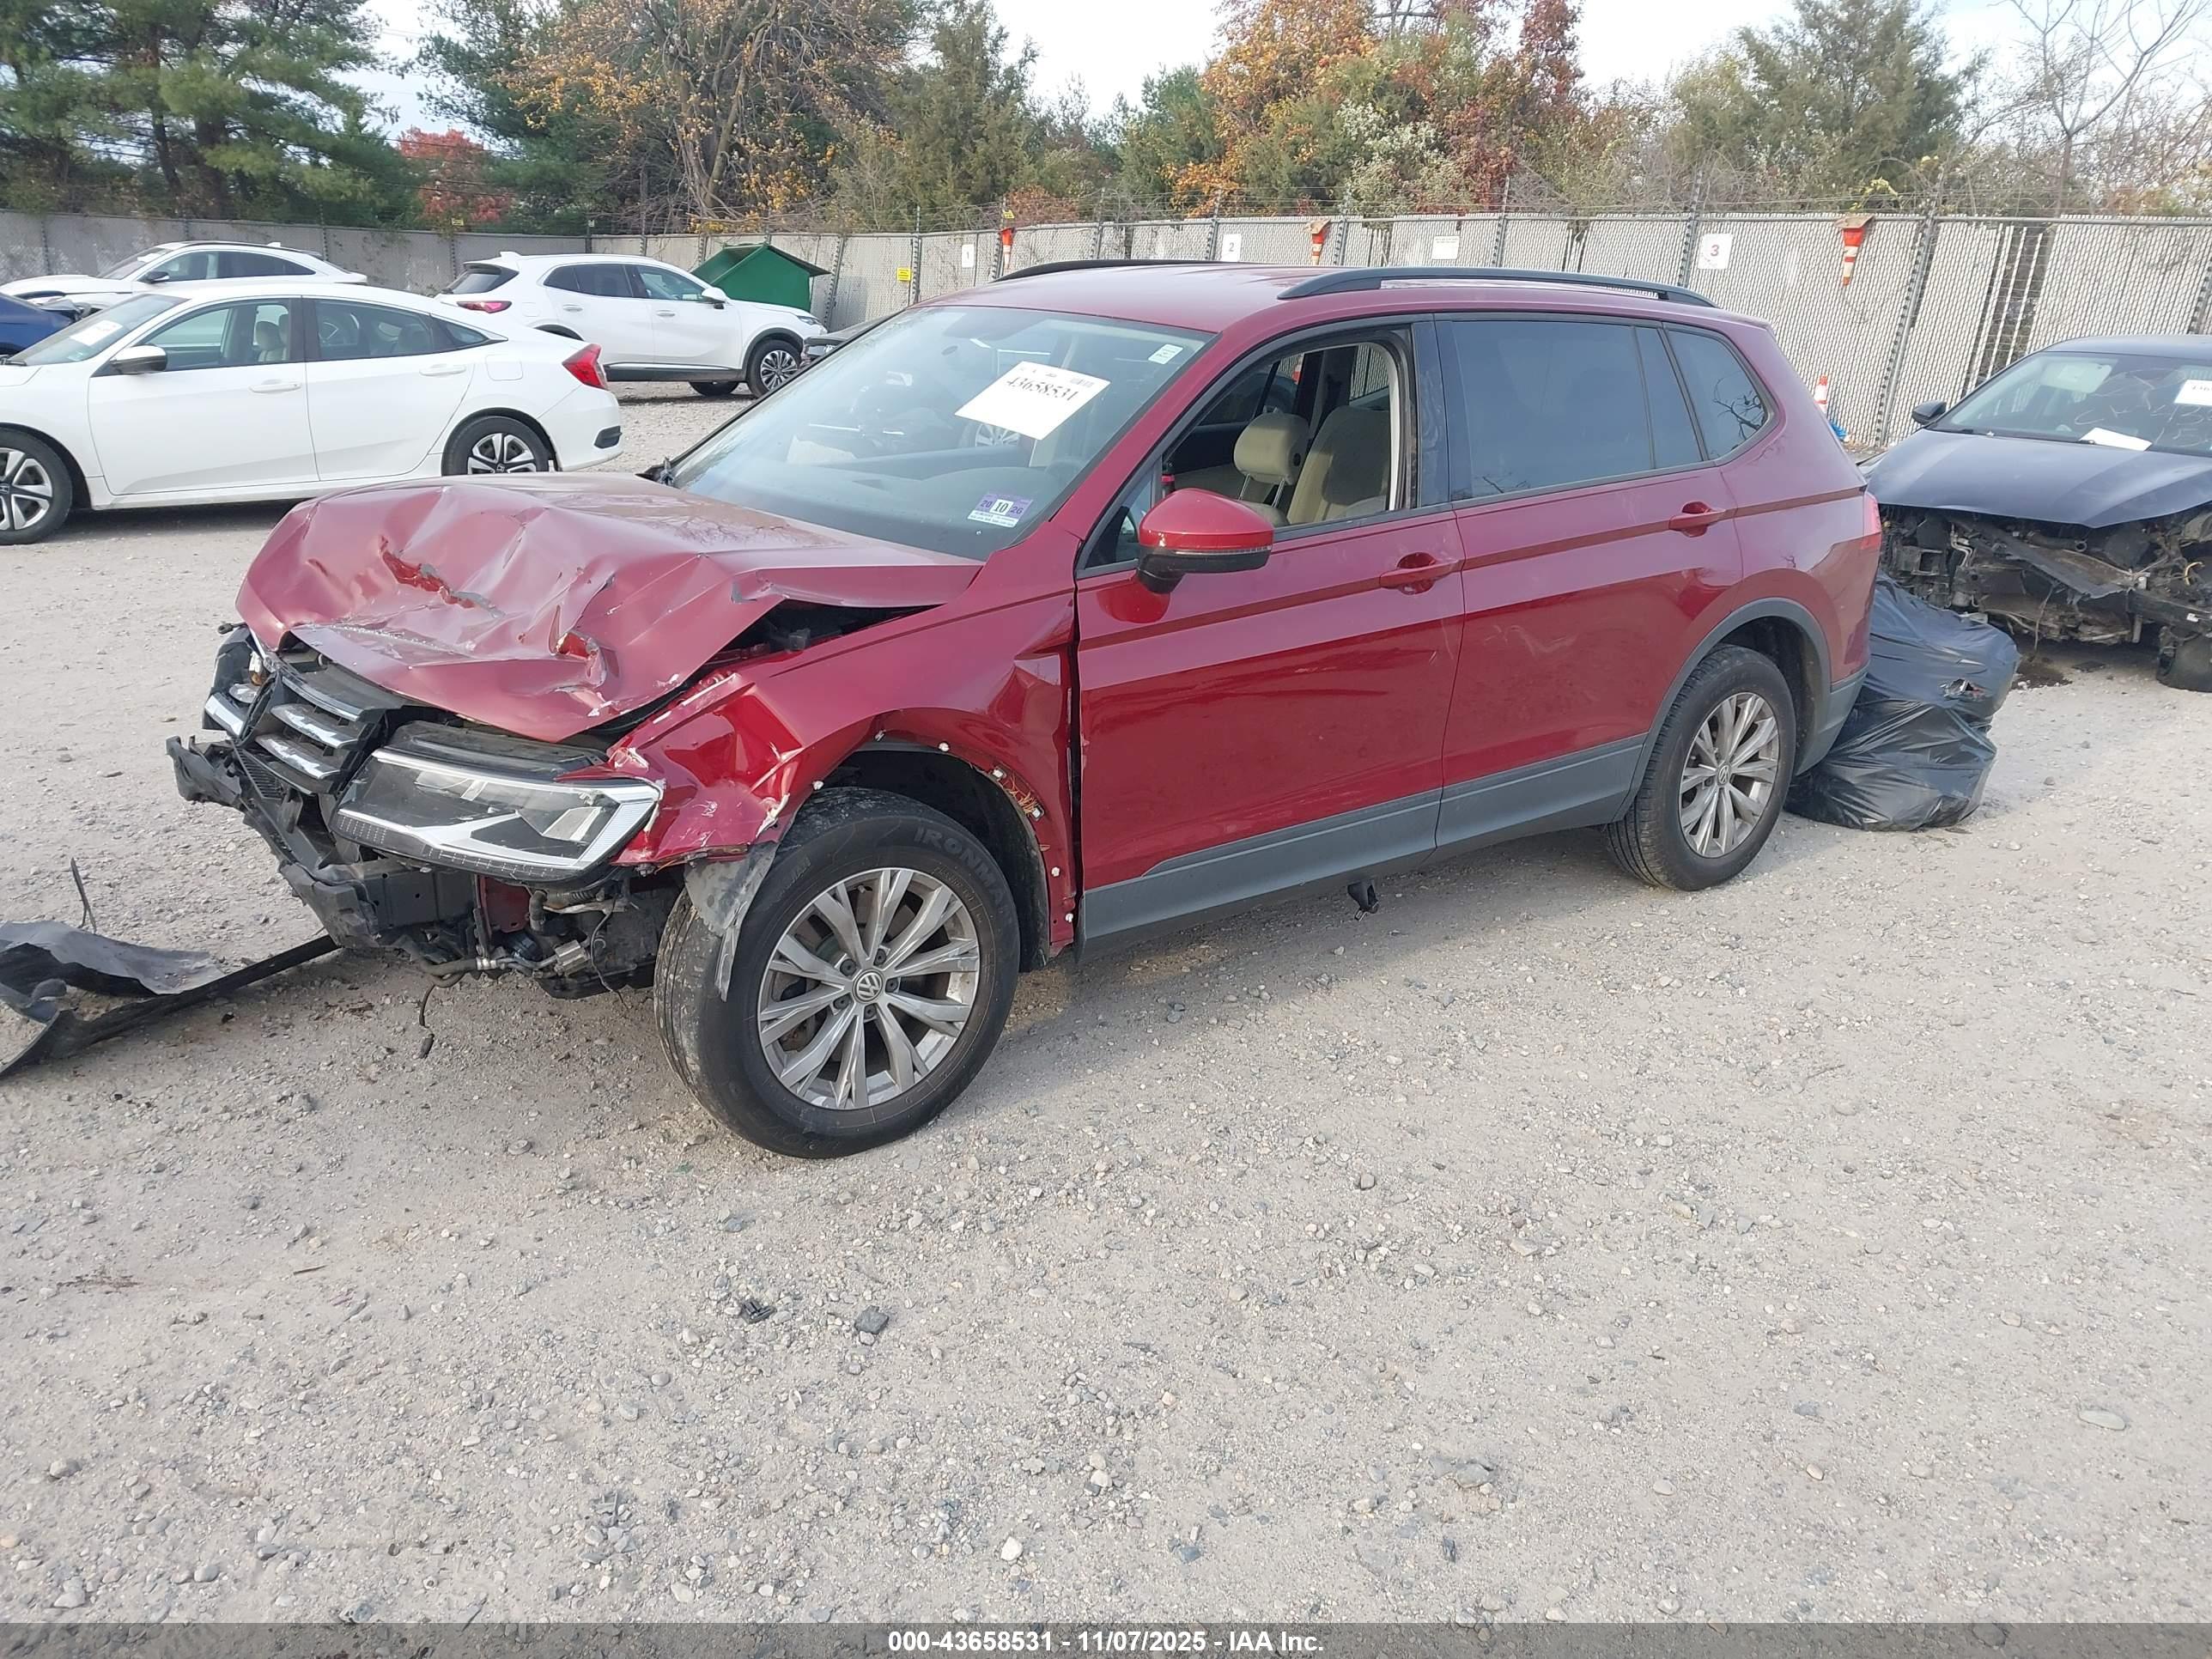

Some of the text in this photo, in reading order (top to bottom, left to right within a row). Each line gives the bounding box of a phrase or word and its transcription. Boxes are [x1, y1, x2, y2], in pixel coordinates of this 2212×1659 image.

[1229, 242, 1235, 252] 2
[1710, 244, 1720, 257] 3
[1006, 376, 1079, 401] 43658531
[993, 501, 1009, 514] 10
